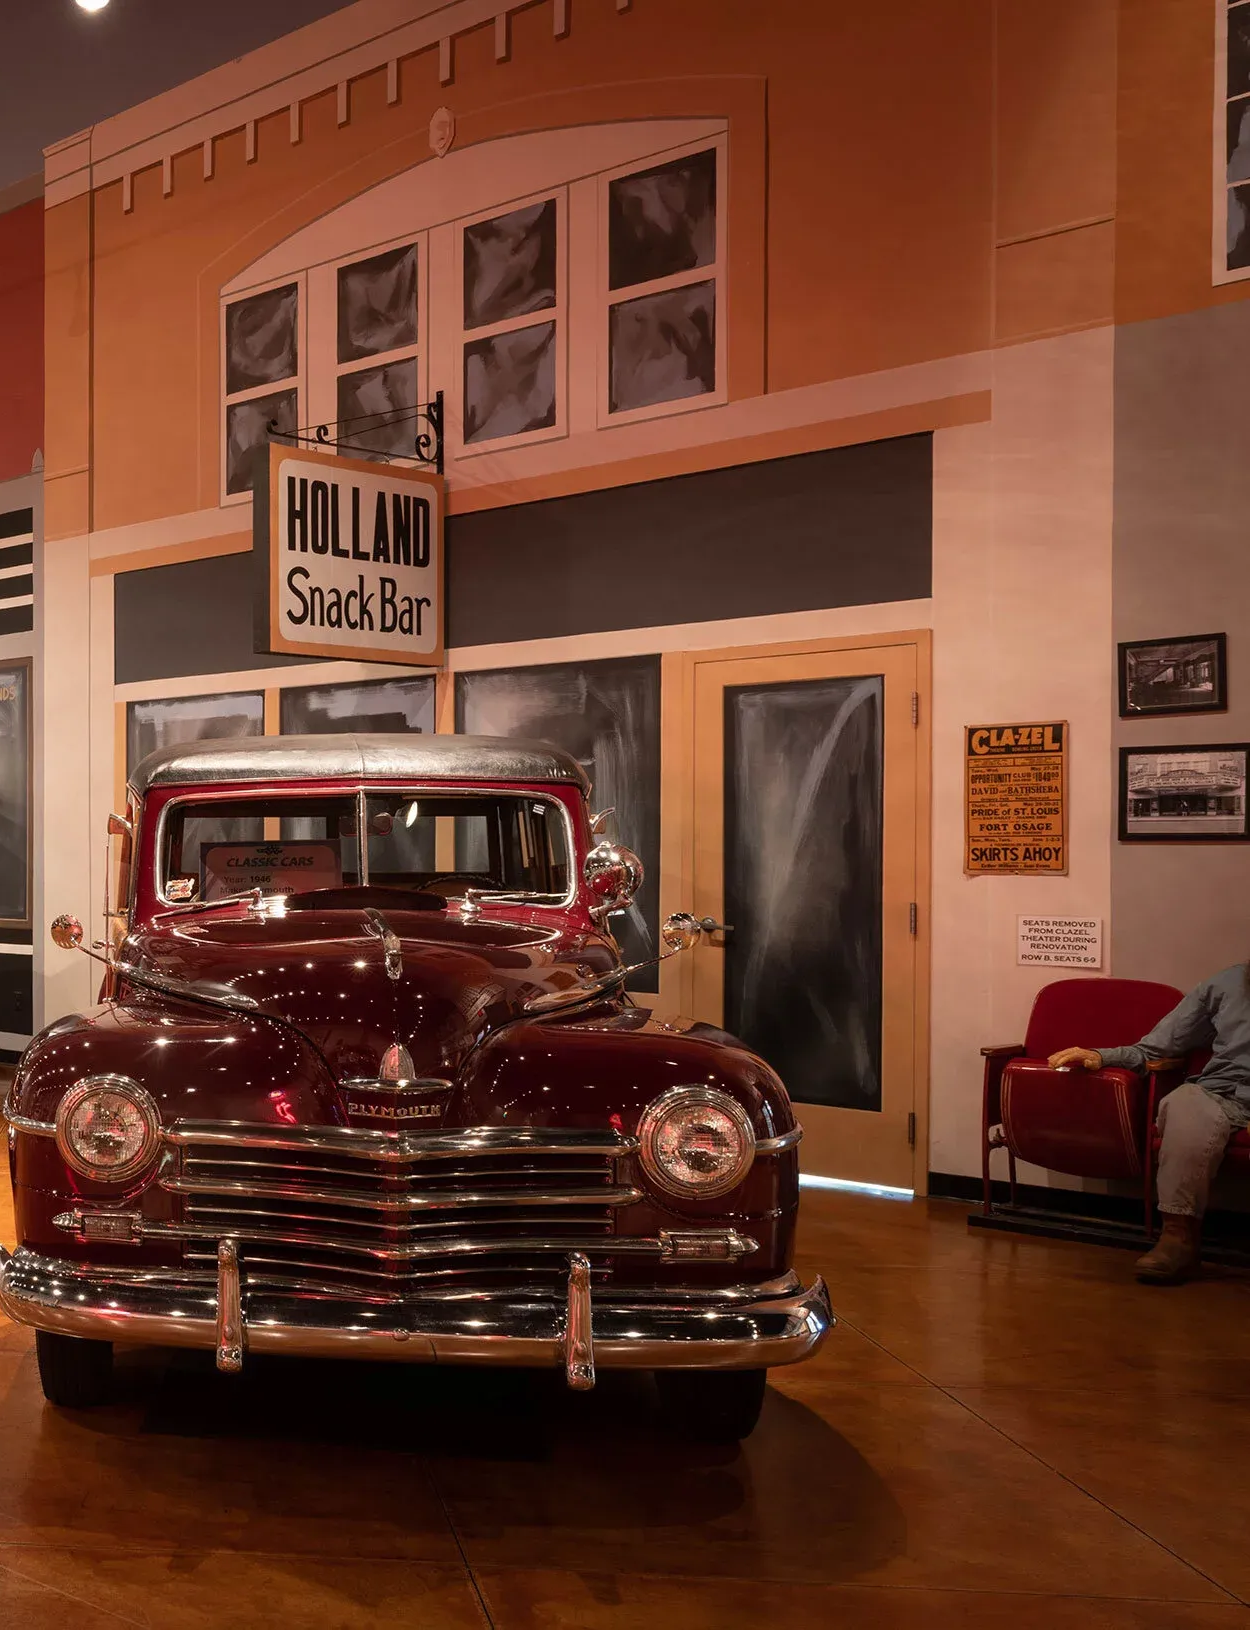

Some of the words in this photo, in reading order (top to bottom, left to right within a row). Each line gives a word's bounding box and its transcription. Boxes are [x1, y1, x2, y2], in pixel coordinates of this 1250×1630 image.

[287, 476, 431, 568] HOLLAND
[286, 566, 375, 632] Snack
[379, 576, 432, 636] Bar
[971, 726, 1061, 755] CLA-ZEL
[972, 787, 999, 795] DAVID
[1007, 785, 1060, 794] BATHSHEBA
[971, 808, 1000, 816] PRIDE
[1031, 807, 1060, 815] LOUIS
[979, 823, 1009, 831] FORT
[1013, 823, 1052, 831] OSAGE
[971, 848, 1019, 862] SKIRTS
[1022, 847, 1061, 861] AHOY
[226, 857, 280, 868] CLASSIC
[281, 856, 314, 867] CARS
[1022, 919, 1050, 927] SEATS
[1051, 920, 1096, 928] REMOVED
[1028, 927, 1053, 935] FROM
[1055, 928, 1090, 936] CLAZEL
[1021, 935, 1062, 943] THEATER
[1062, 936, 1097, 944] DURING
[1030, 942, 1087, 951] RENOVATION
[1053, 955, 1082, 963] SEATS
[348, 1102, 441, 1117] PLYMOUTH
